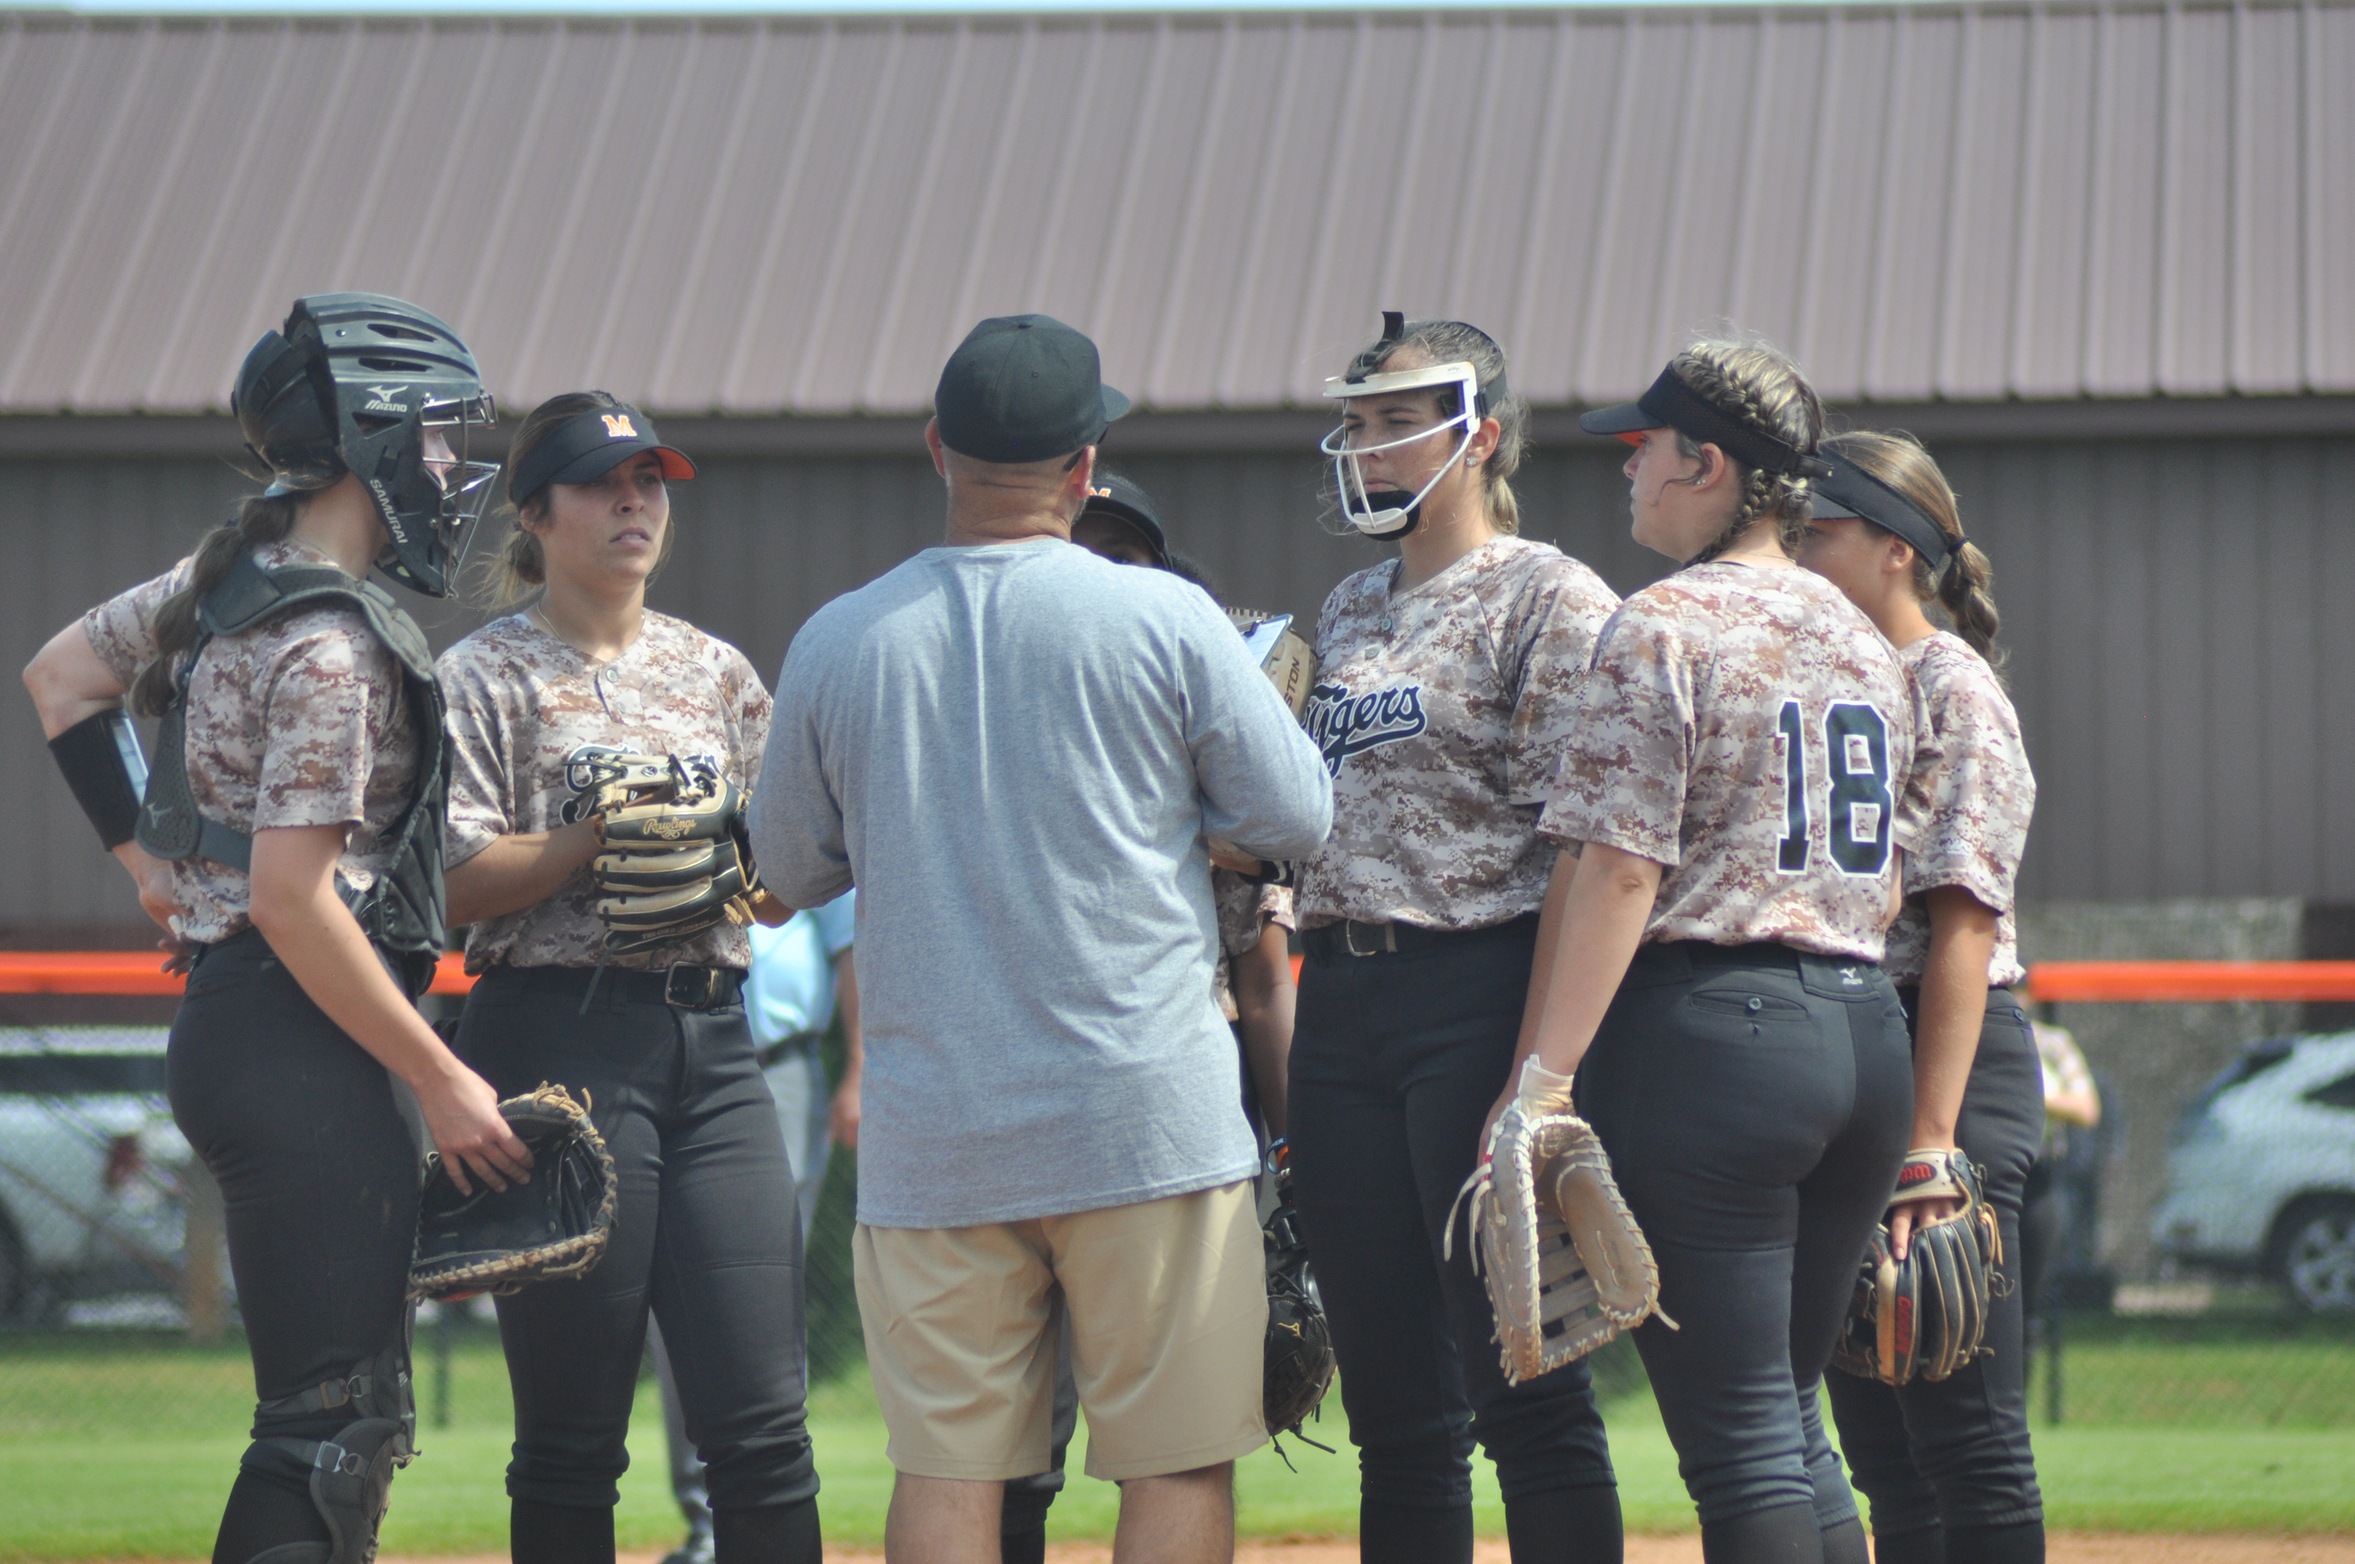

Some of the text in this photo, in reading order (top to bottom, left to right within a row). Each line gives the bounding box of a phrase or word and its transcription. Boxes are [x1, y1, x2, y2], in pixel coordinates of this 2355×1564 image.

[600, 414, 638, 437] M
[369, 479, 409, 543] SAMURAI
[1283, 656, 1300, 708] STON
[1776, 697, 1894, 879] 18
[643, 817, 697, 837] Rawlings
